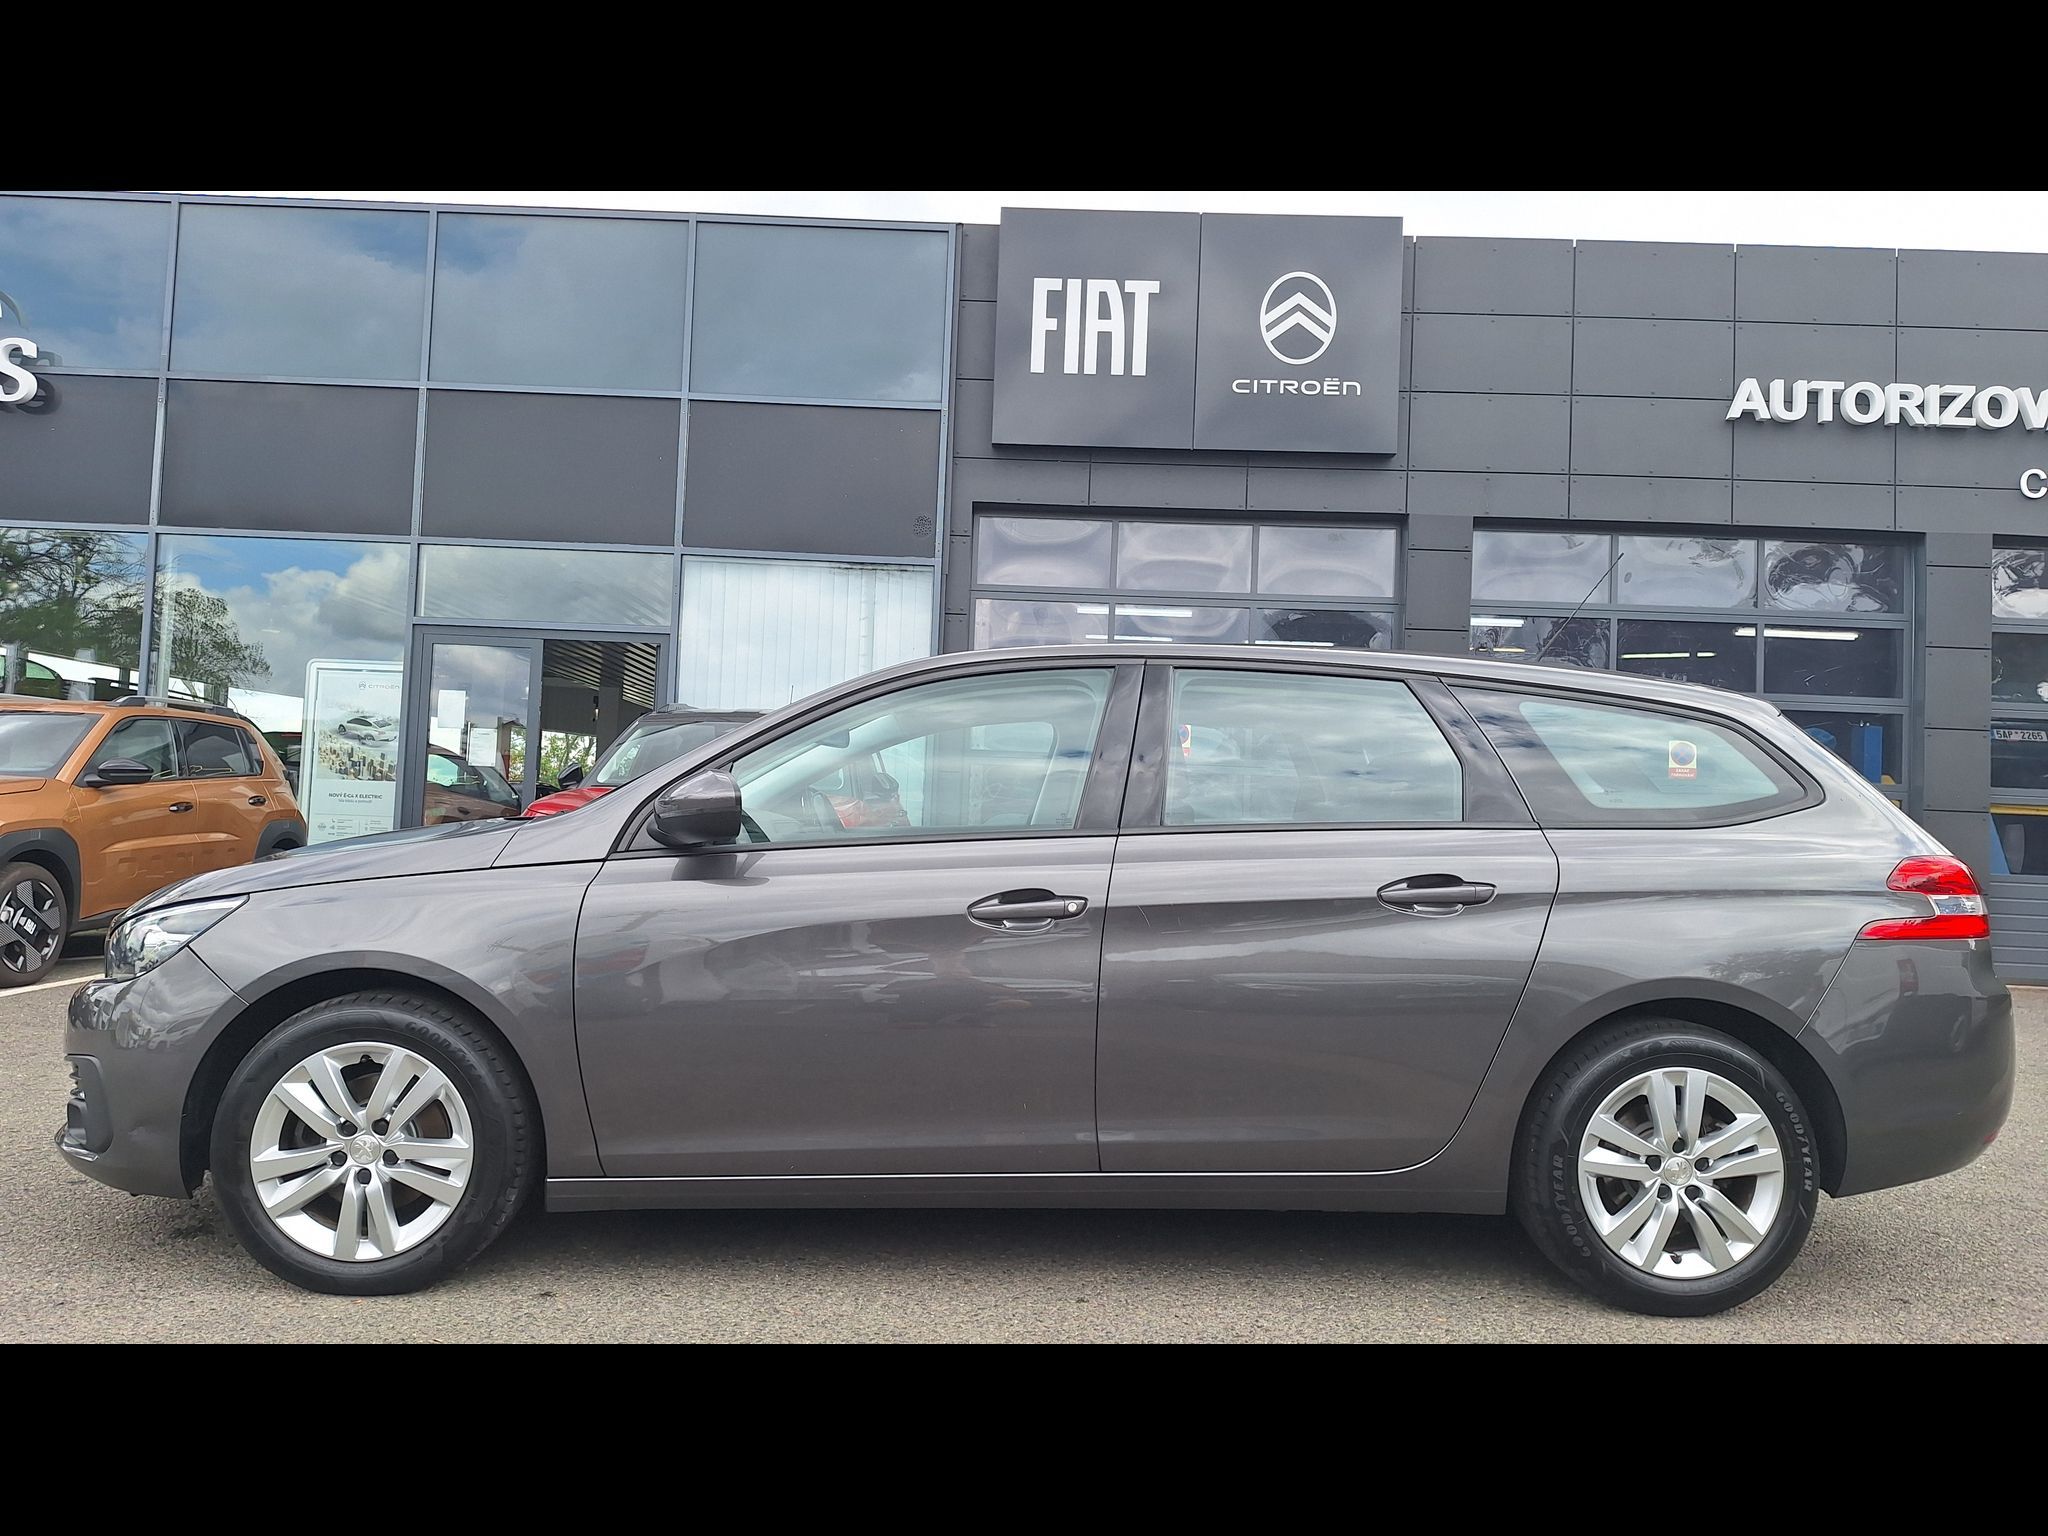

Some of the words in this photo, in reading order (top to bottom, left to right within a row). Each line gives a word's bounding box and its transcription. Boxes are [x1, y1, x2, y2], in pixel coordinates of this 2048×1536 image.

[1030, 277, 1160, 377] FIAT
[1231, 377, 1361, 396] CITROËN
[1725, 377, 2048, 431] AUTORIZOV
[1996, 730, 2013, 739] 5AP
[2020, 731, 2044, 740] 2265
[1776, 1091, 1813, 1192] GOODYEAR
